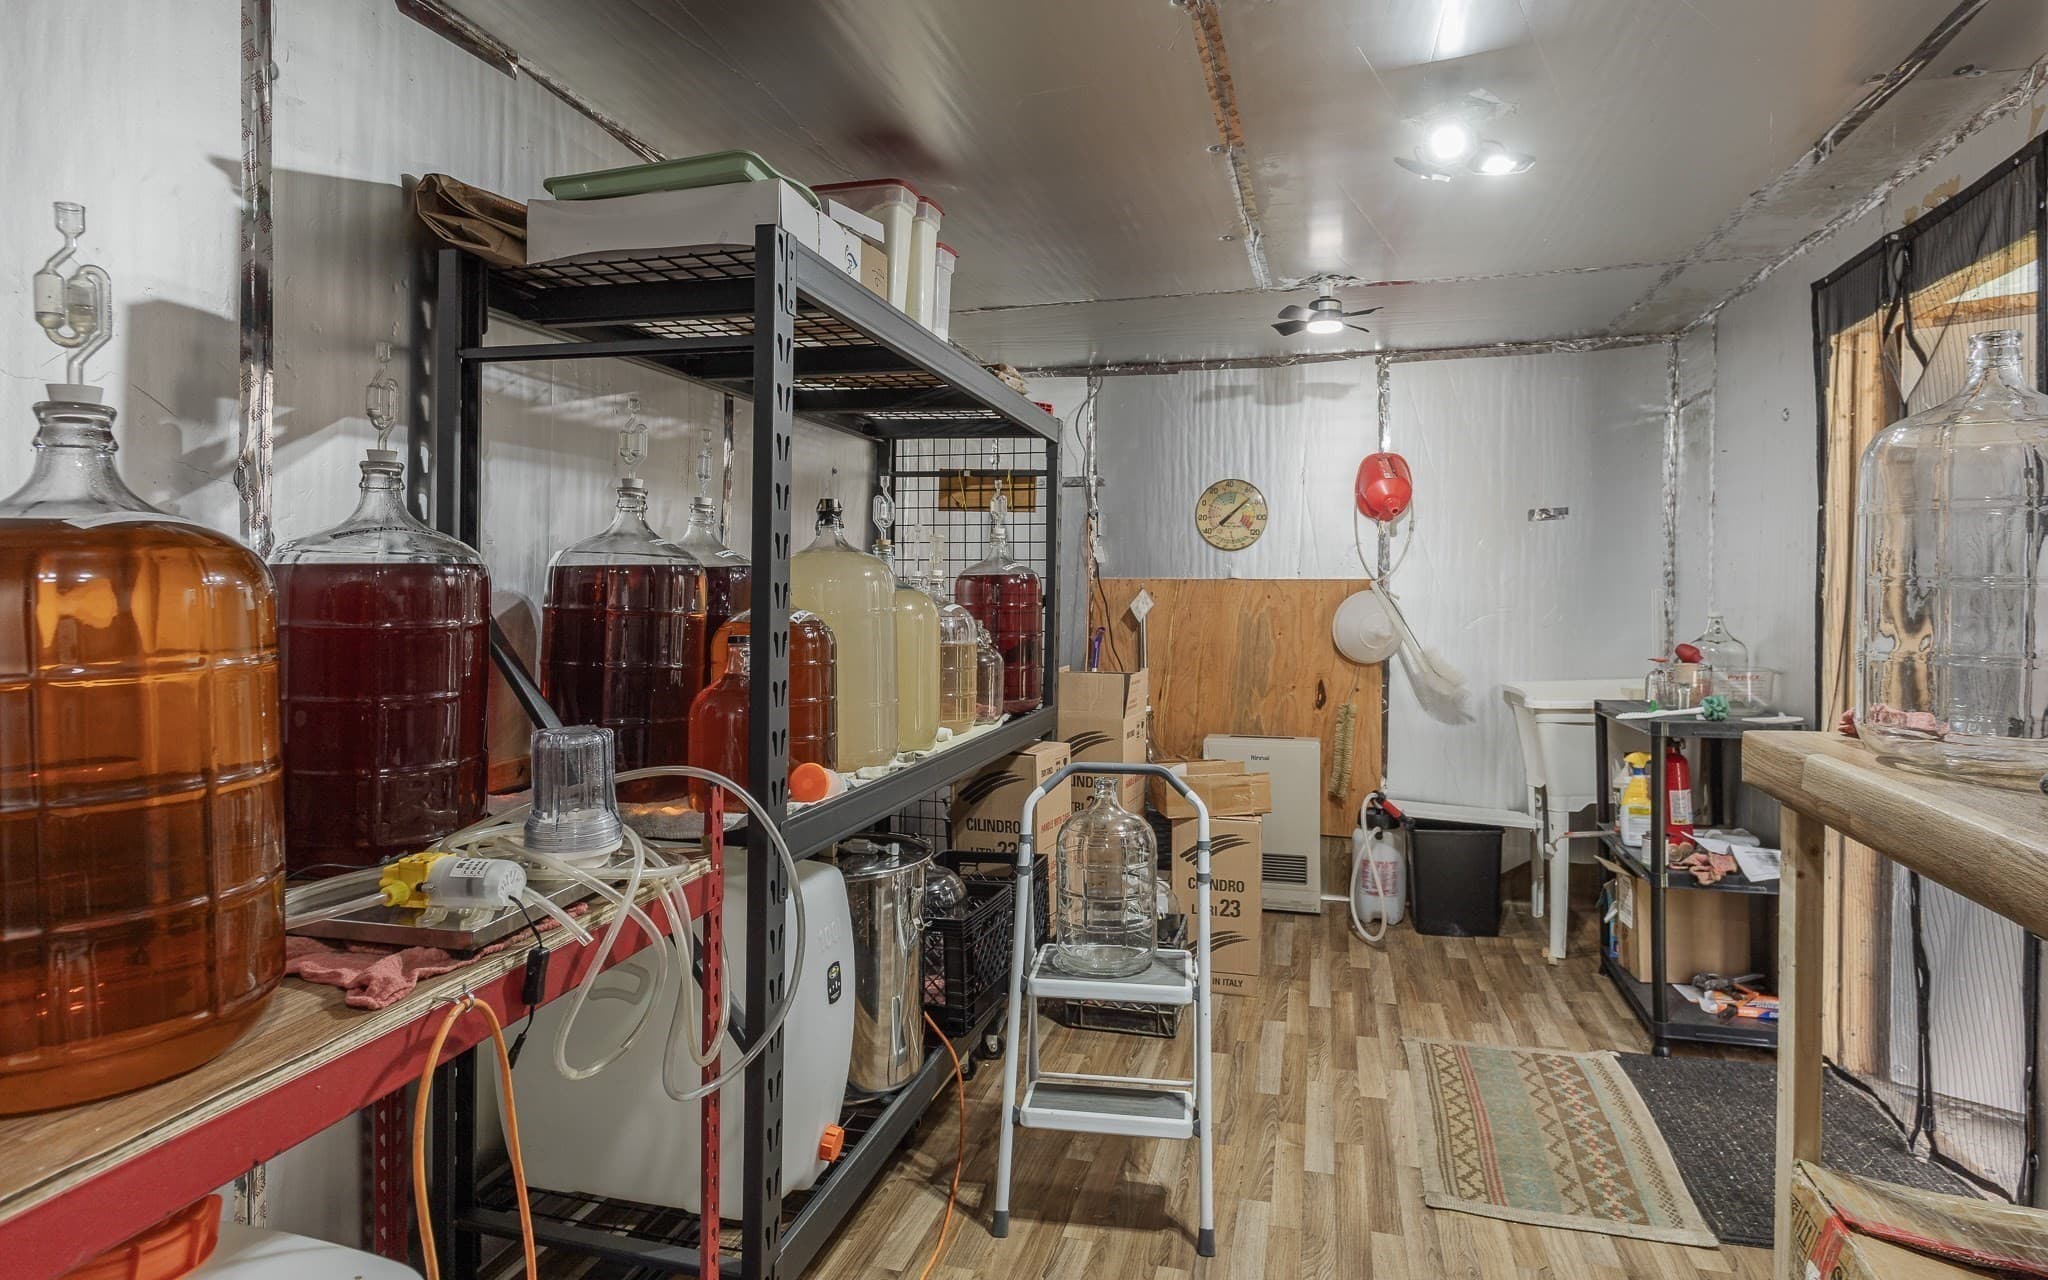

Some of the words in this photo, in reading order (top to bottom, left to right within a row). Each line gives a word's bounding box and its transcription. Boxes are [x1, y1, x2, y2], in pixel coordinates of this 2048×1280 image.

[966, 817, 1021, 834] CILINDRO
[1191, 904, 1218, 916] LRI
[1220, 898, 1241, 918] 23
[1222, 978, 1243, 987] ITALY
